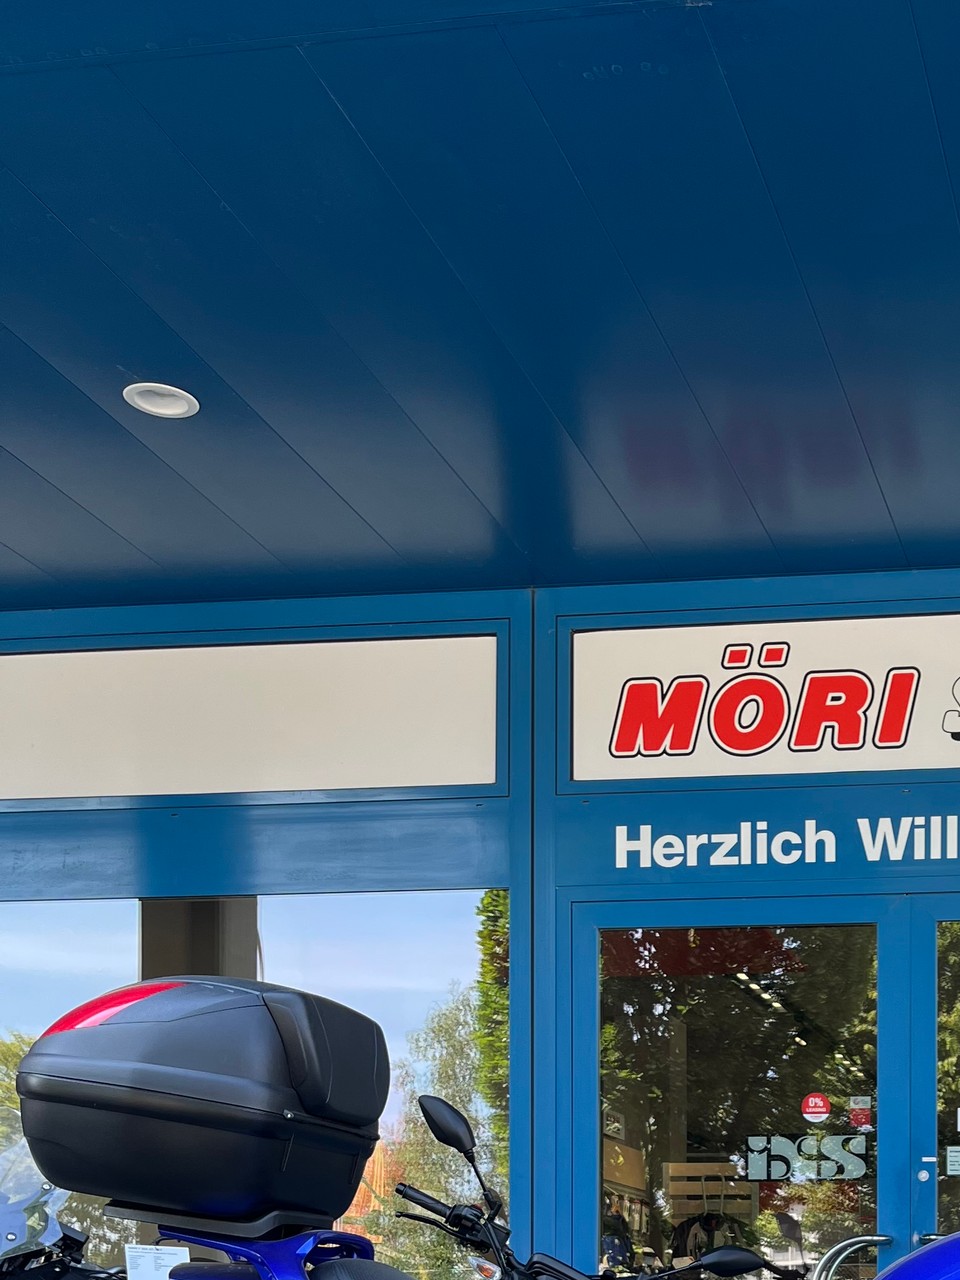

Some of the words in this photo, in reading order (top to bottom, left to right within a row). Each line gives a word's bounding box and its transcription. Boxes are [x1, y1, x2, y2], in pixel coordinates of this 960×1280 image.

[609, 642, 920, 758] MÖRI
[614, 819, 836, 868] Herzlich
[808, 1097, 824, 1107] 0%
